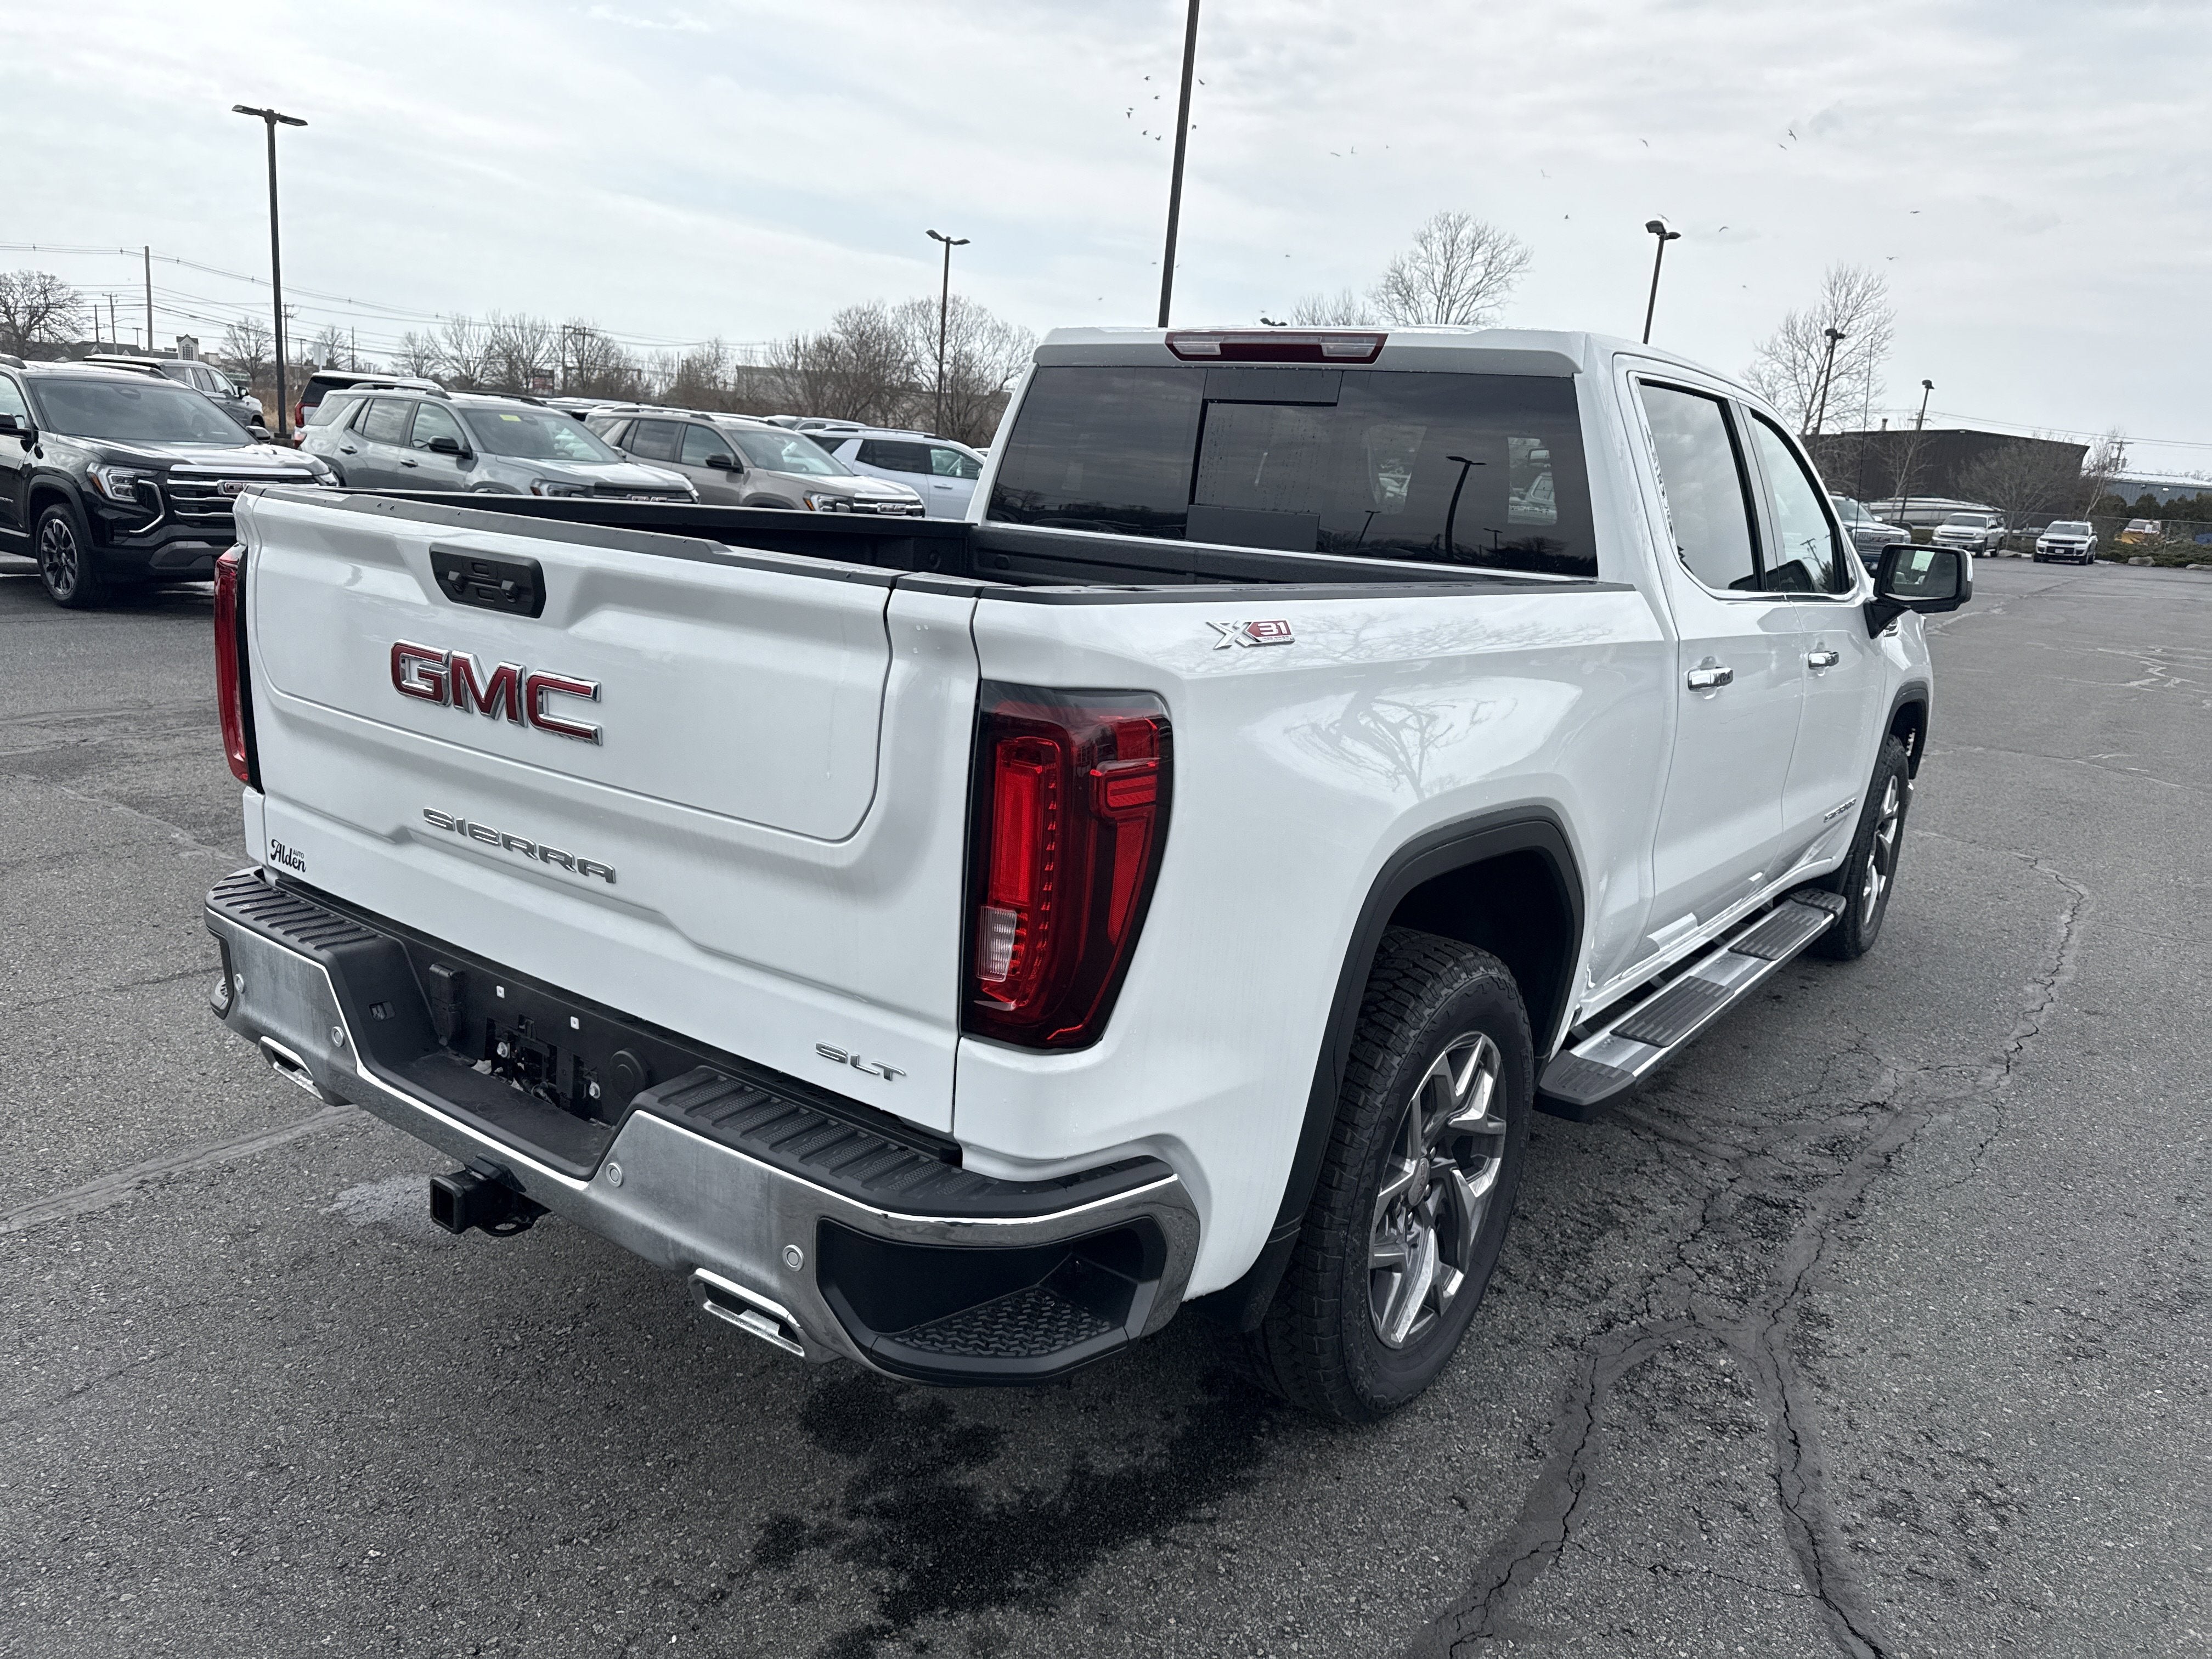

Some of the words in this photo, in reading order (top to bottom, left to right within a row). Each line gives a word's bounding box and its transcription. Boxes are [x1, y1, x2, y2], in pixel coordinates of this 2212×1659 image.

[1206, 620, 1288, 650] X31
[391, 639, 602, 746] GMC
[270, 839, 307, 873] Alden
[293, 849, 304, 859] AUTO
[423, 807, 616, 884] SIERRA
[815, 1042, 906, 1081] SLT
